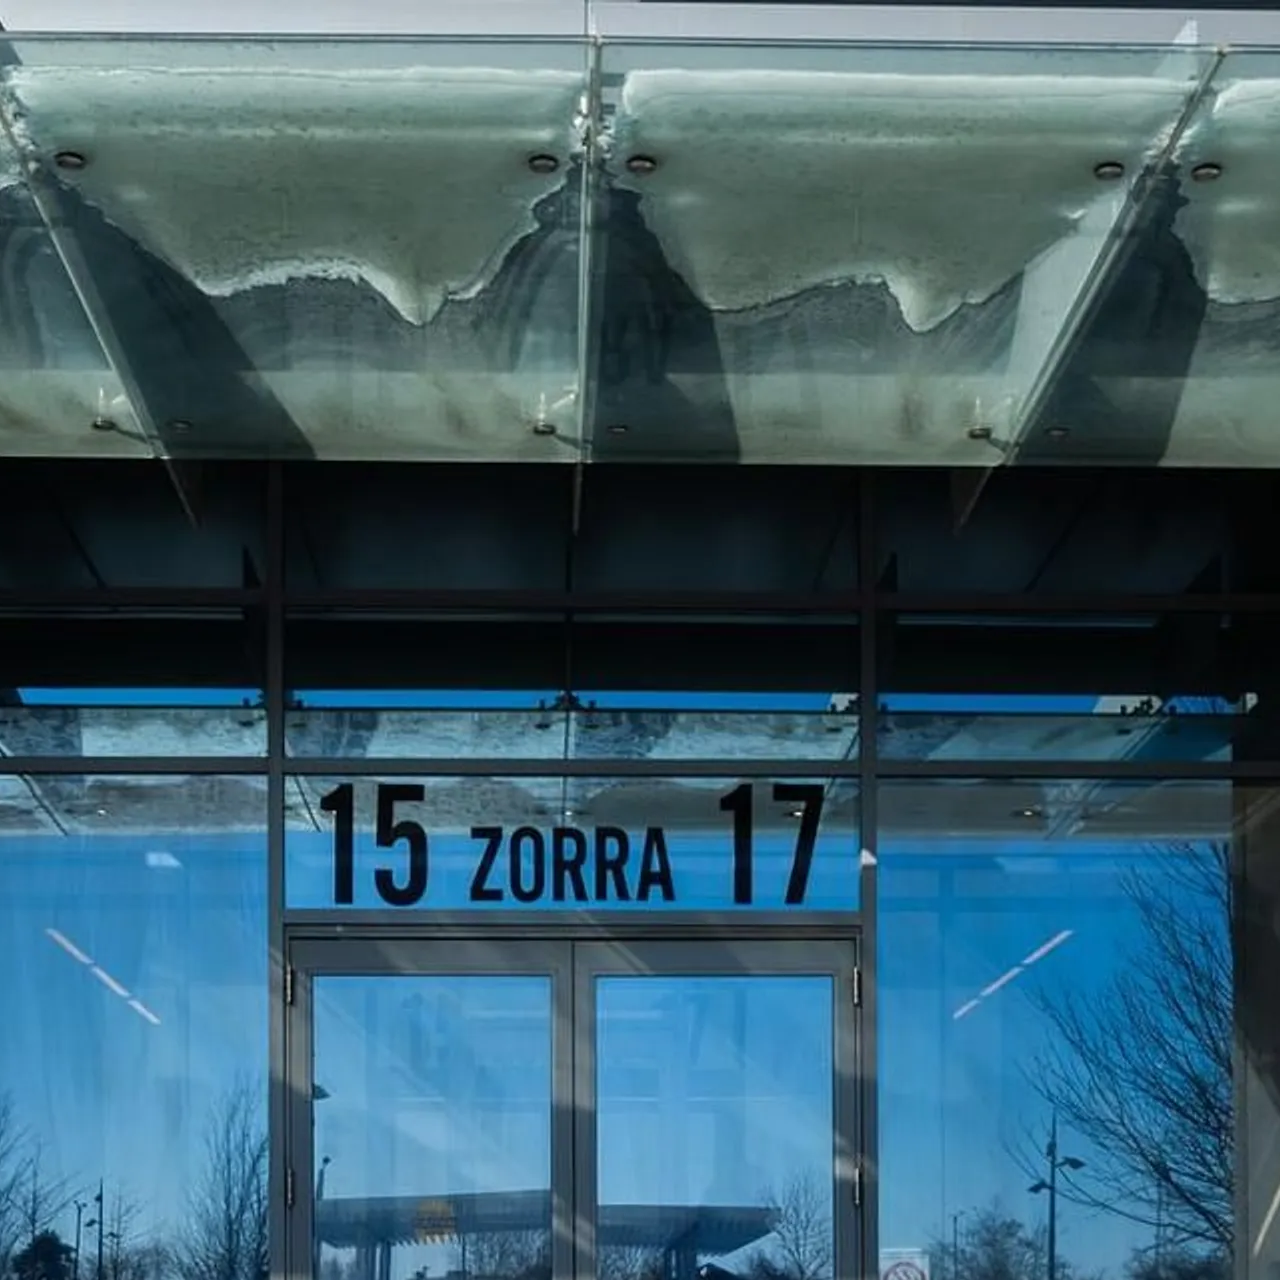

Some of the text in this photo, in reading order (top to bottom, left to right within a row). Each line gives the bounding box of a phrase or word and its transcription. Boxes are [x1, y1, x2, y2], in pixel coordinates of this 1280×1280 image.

[320, 783, 825, 906] 15 ZORRA 17
